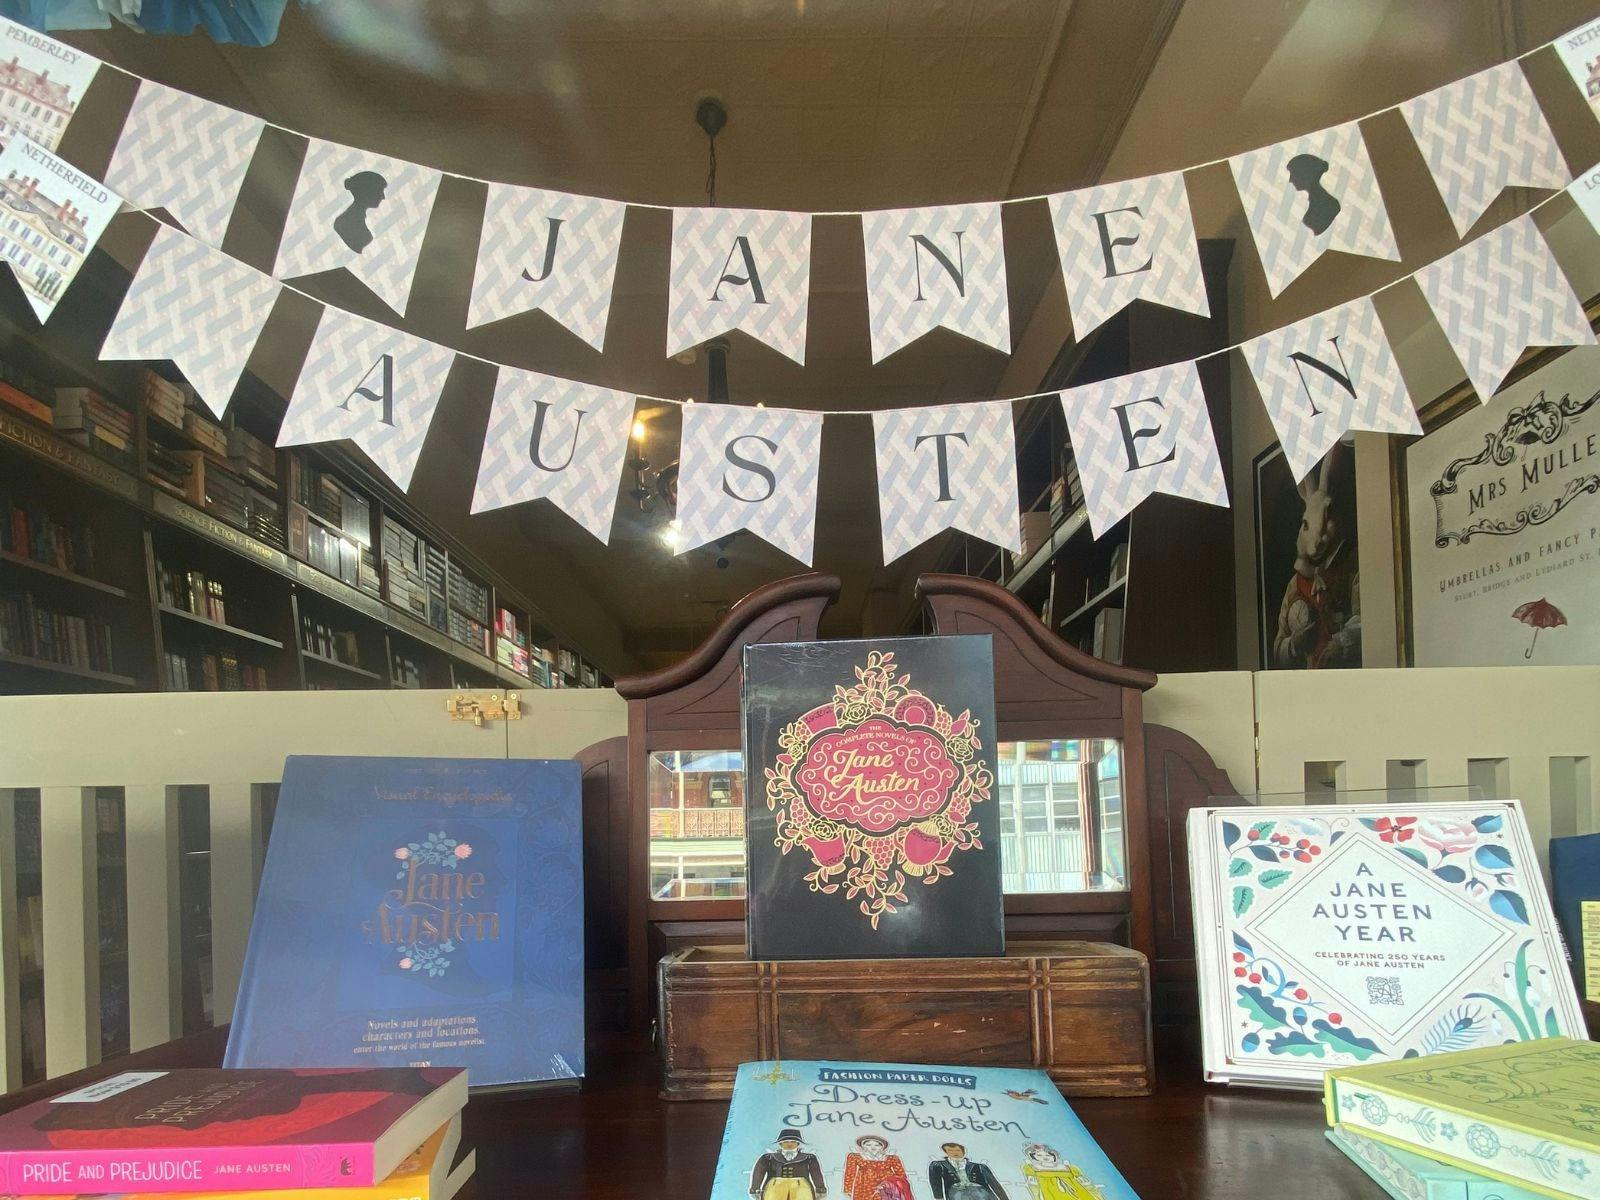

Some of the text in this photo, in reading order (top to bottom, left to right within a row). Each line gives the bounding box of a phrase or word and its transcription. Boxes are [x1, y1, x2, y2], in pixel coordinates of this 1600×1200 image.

[5, 25, 81, 65] PEMBERLEY
[22, 143, 109, 204] NETHERFIELD
[1468, 434, 1598, 516] MRS MULLE
[175, 506, 208, 530] SCIENCE
[209, 523, 237, 544] FICTION
[245, 539, 273, 560] FANTASY
[1440, 563, 1501, 593] UMBRELLAS
[1508, 551, 1531, 568] AND
[1539, 533, 1580, 557] FANCY
[1514, 572, 1532, 584] AND
[836, 732, 874, 747] COMPLETE
[875, 732, 905, 741] NOVELS
[827, 748, 894, 785] Jane
[829, 771, 920, 804] Austen
[1356, 862, 1374, 877] A
[385, 858, 486, 908] Jane
[1329, 882, 1407, 898] JANE
[1312, 903, 1433, 920] AUSTEN
[361, 902, 499, 945] Austen
[1334, 925, 1417, 942] YEAR
[1315, 951, 1446, 962] CELEBRATING 250 YEARS
[1354, 960, 1381, 968] JANE
[1384, 961, 1425, 969] AUSTEN
[362, 1031, 412, 1042] characters
[416, 1028, 433, 1038] and
[368, 1018, 398, 1030] Novels
[401, 1017, 419, 1028] and
[824, 1070, 973, 1087] FASHION PAPER DOLLS
[811, 1083, 992, 1115] Dress-up
[783, 1102, 1031, 1139] Jane Austen
[23, 1160, 291, 1183] PRIDE AND PREJUDICE JANE AUSTEN
